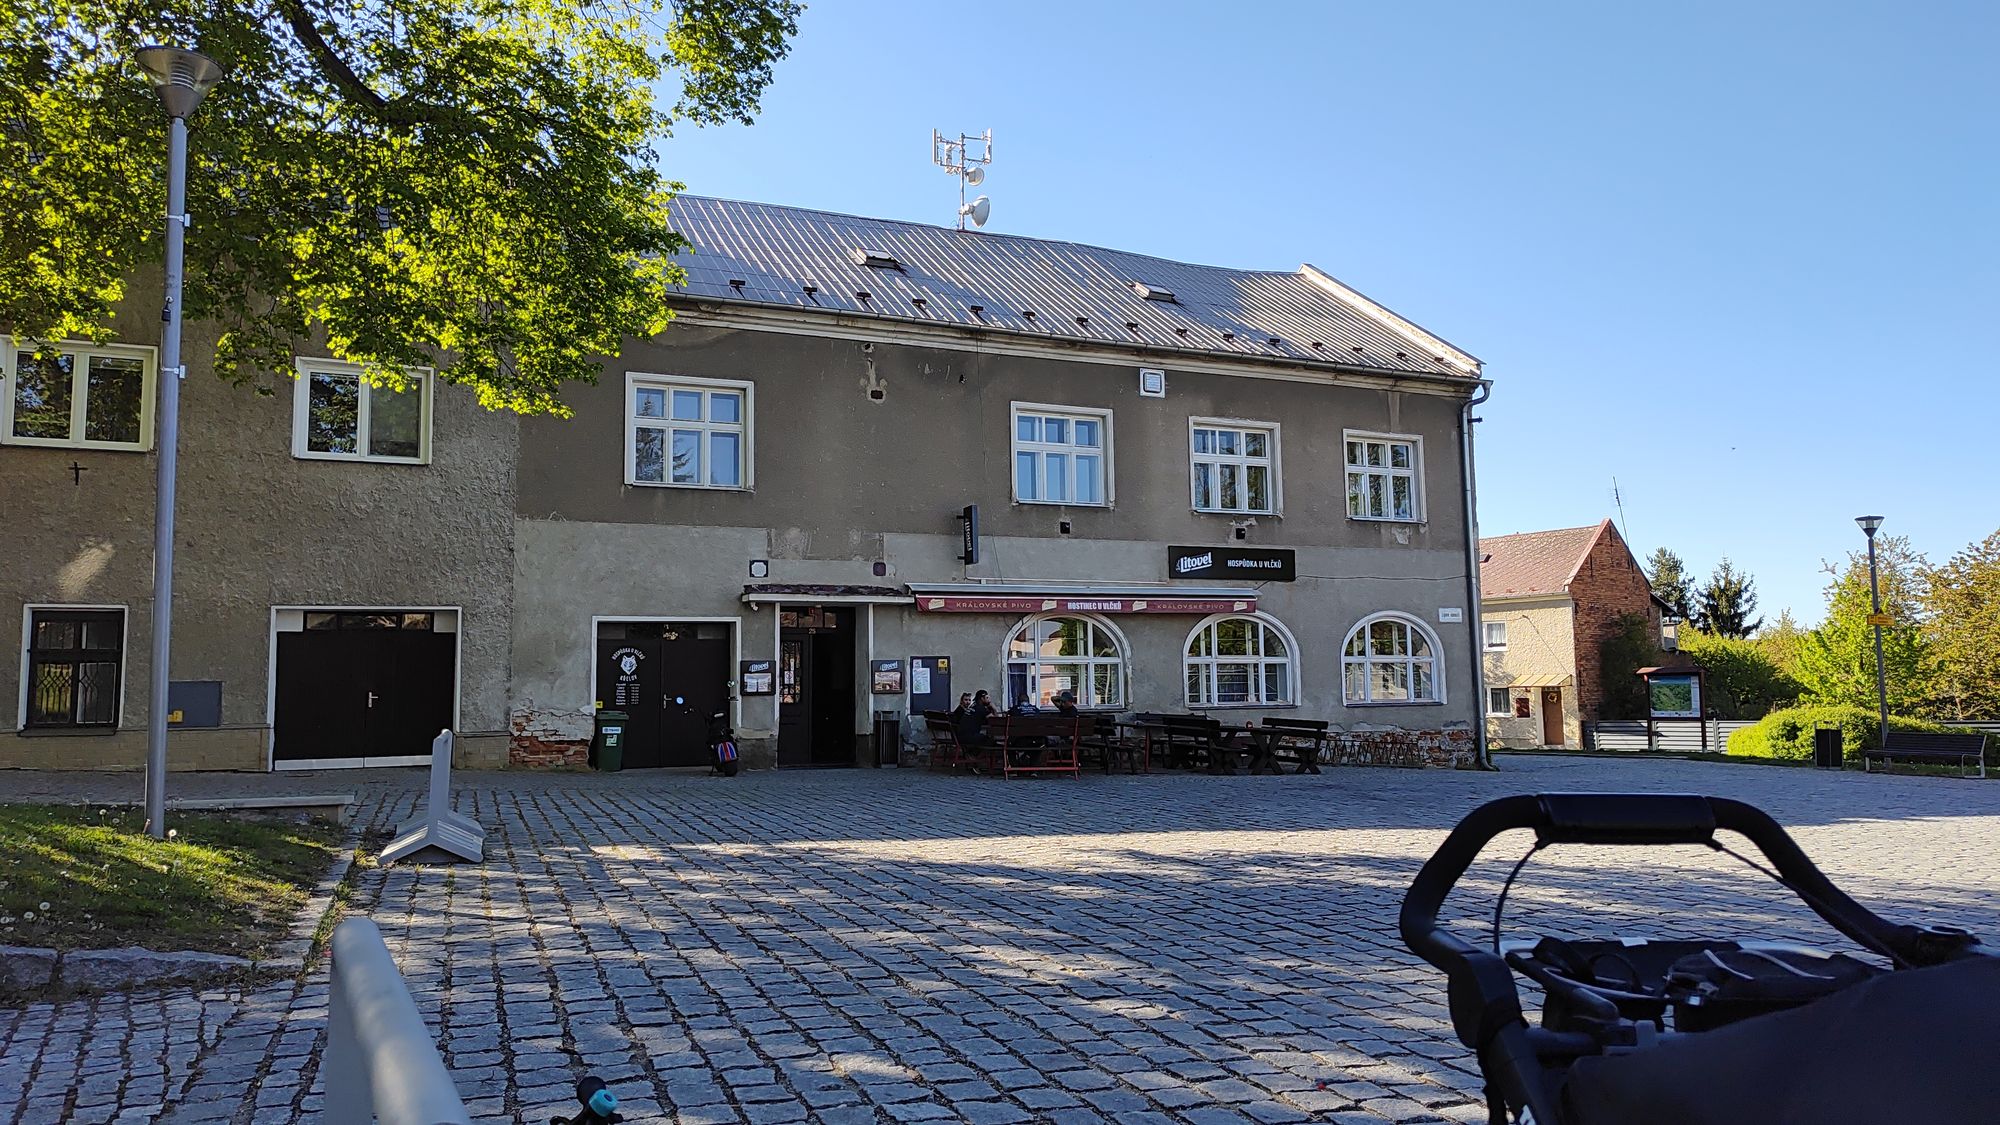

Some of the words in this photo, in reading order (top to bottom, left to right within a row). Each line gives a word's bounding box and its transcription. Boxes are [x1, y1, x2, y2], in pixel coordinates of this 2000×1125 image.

[1180, 551, 1212, 573] Litovel
[1227, 558, 1258, 568] HOSPŮDKA
[1258, 560, 1263, 568] U
[1264, 559, 1282, 569] VLČKŮ
[1067, 601, 1097, 610] HOSTINEC
[1103, 601, 1122, 610] VLČKŮ
